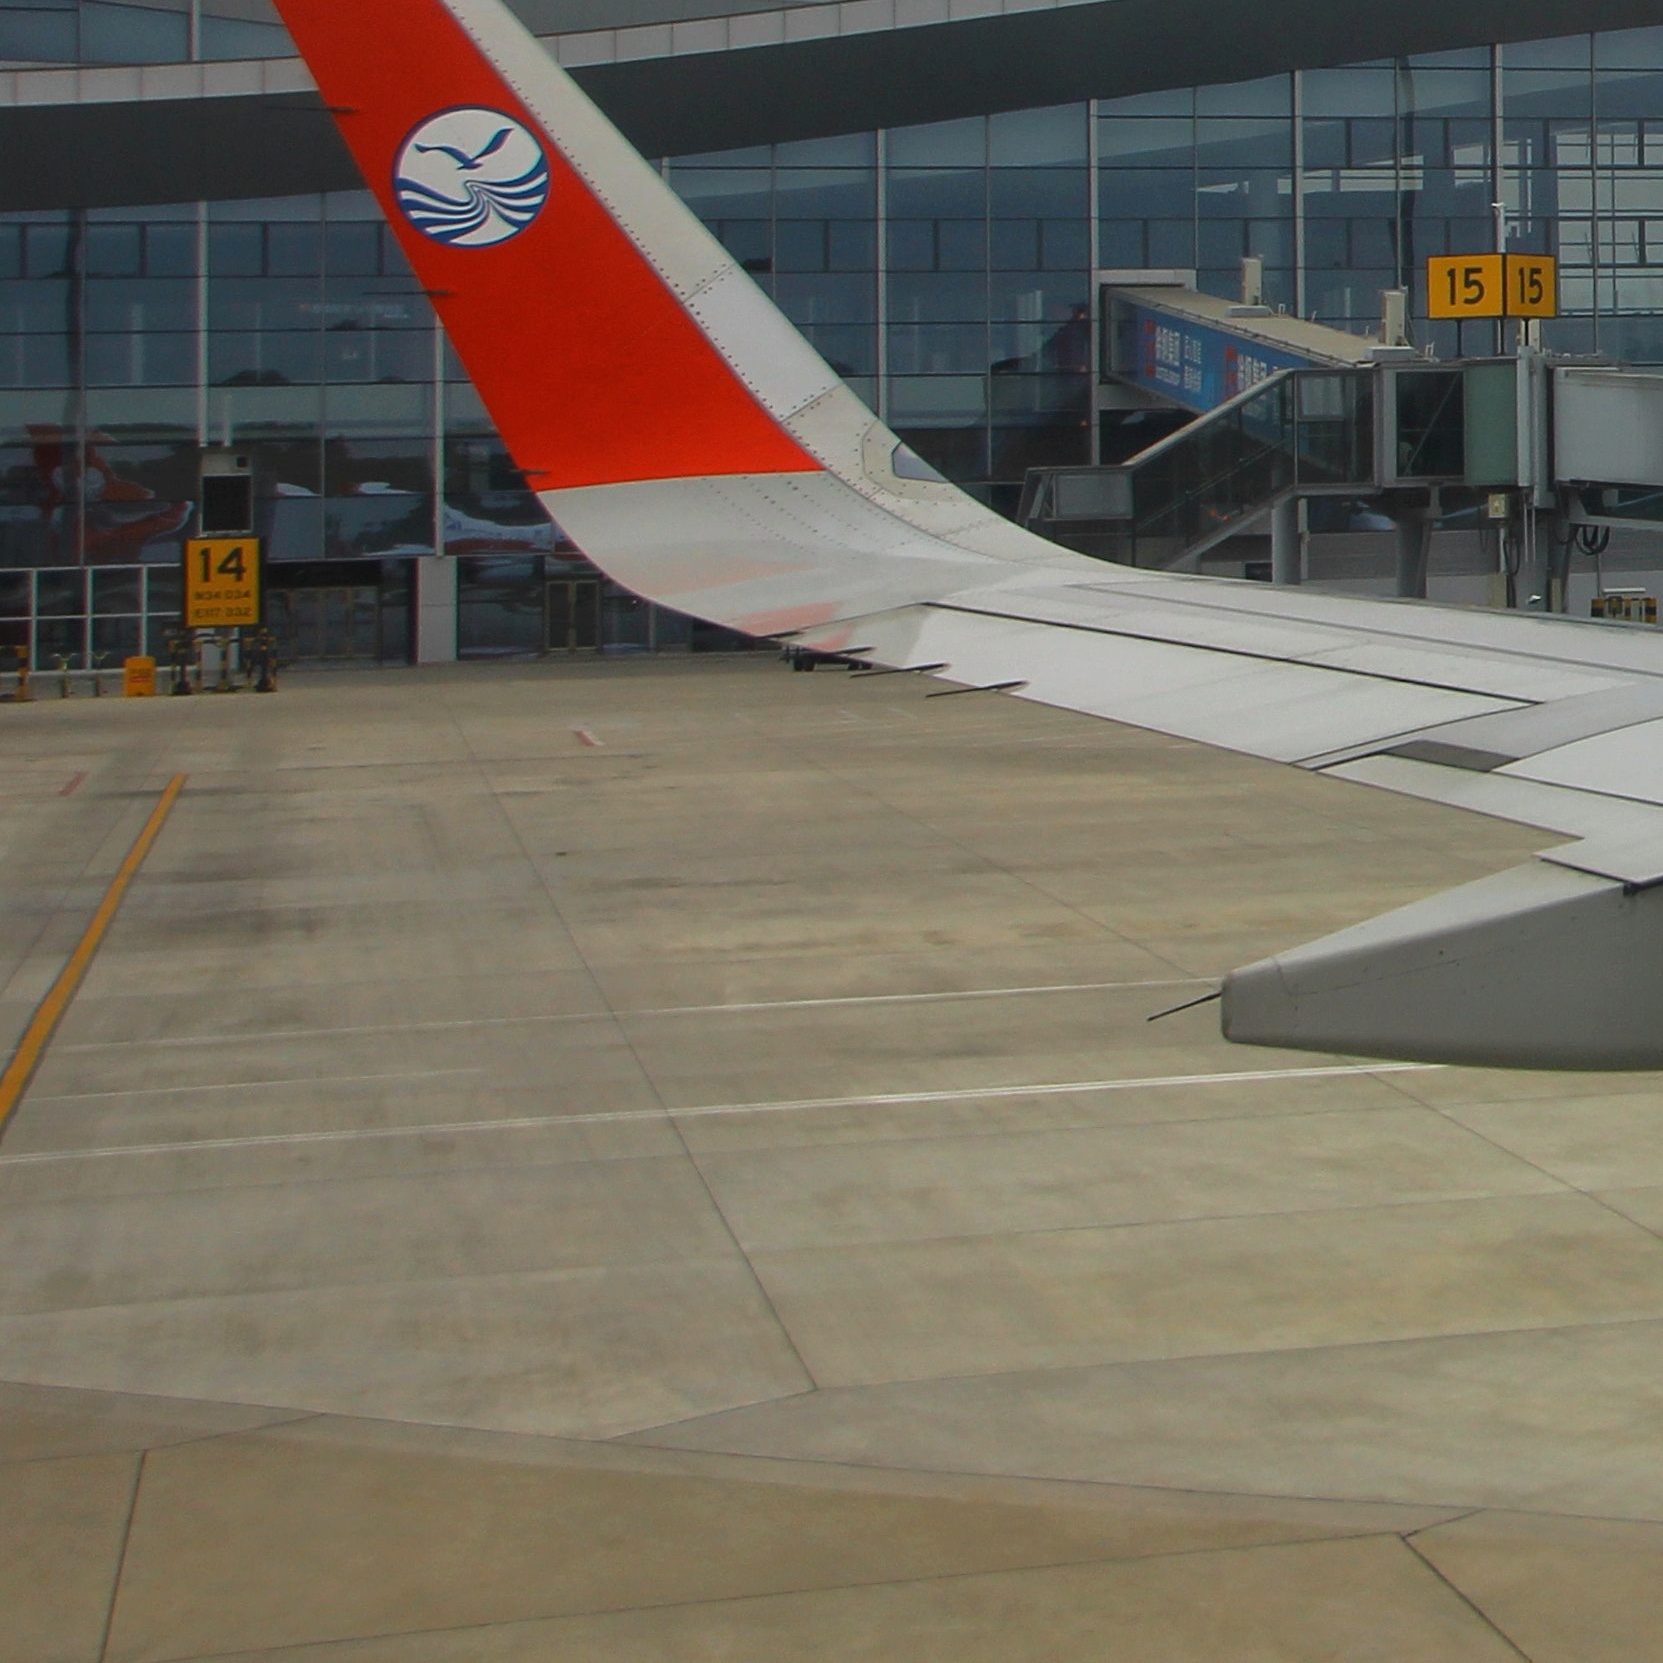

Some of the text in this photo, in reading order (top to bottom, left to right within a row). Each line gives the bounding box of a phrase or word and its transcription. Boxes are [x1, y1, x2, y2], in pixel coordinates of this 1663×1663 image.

[1447, 267, 1485, 305] 15
[1518, 267, 1543, 305] 15
[199, 546, 247, 583] 14
